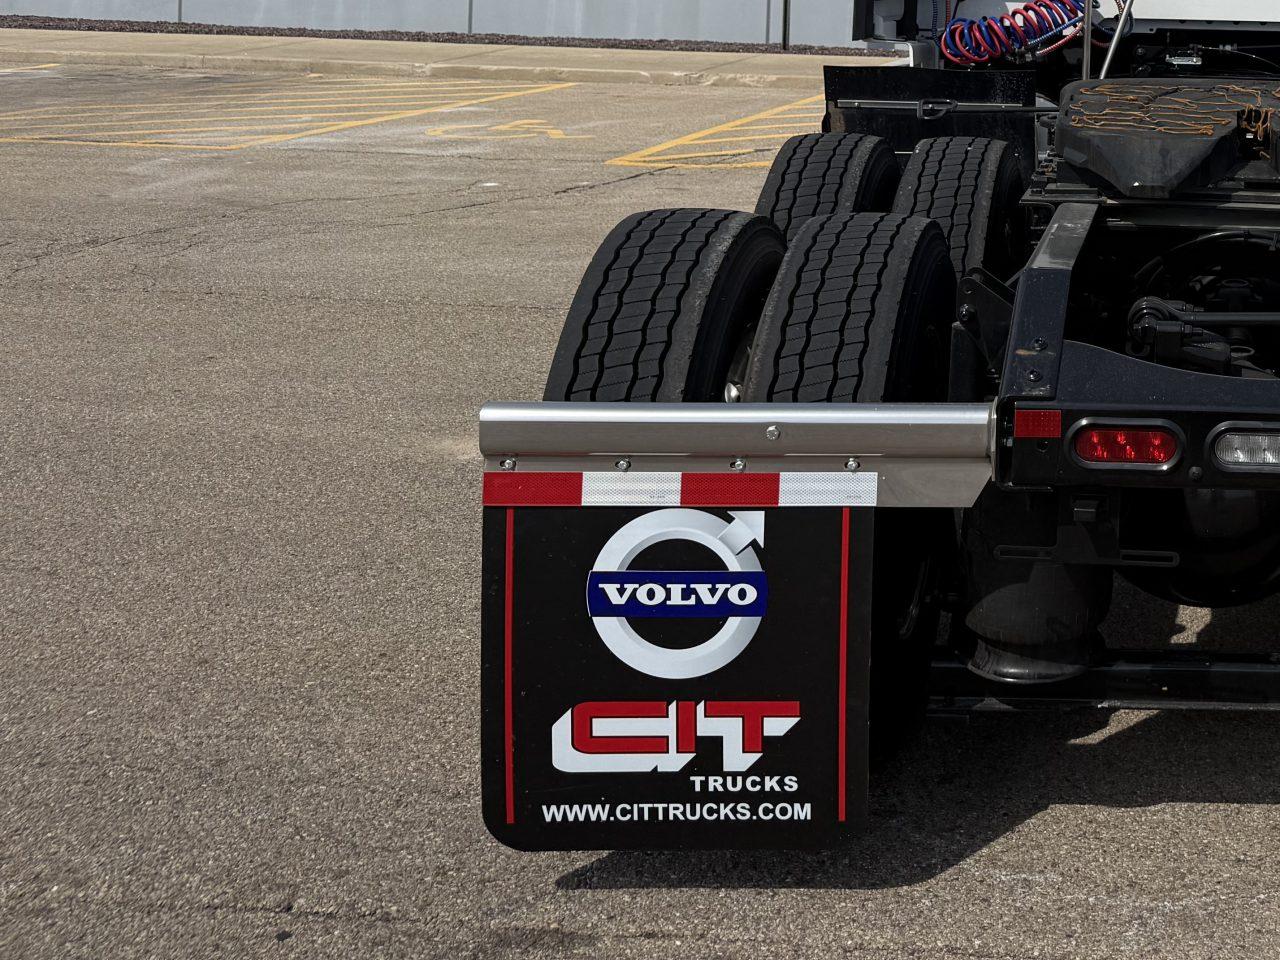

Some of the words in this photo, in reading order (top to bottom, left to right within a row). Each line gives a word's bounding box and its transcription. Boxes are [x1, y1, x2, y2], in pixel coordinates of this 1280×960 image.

[599, 584, 757, 605] VOLVO
[552, 700, 800, 772] CIT
[690, 776, 798, 791] TRUCKS
[542, 803, 811, 821] WWW.CITTRUCKS.COM
